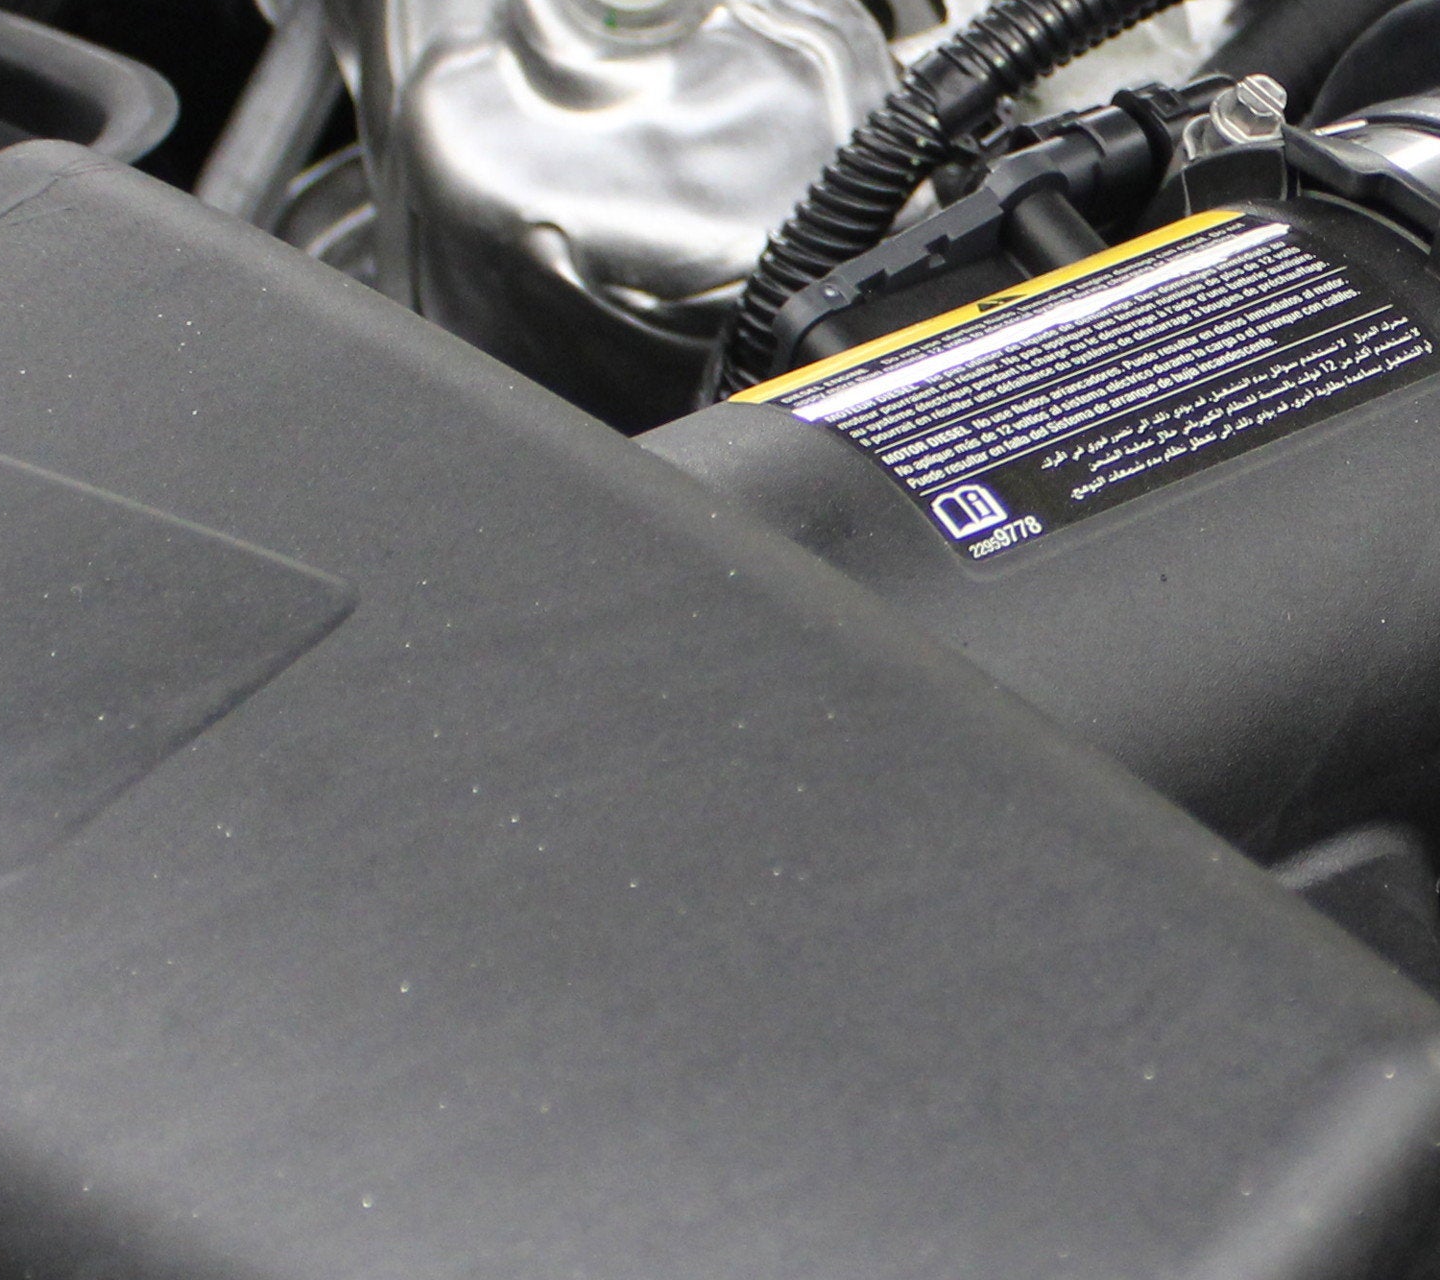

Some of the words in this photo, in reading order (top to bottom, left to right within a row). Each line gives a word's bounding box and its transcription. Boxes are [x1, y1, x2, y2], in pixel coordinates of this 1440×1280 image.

[1257, 255, 1275, 265] 12
[881, 441, 928, 464] MOTOR
[925, 425, 971, 447] DIESEL
[971, 417, 991, 429] No
[989, 409, 1013, 423] use
[1010, 394, 1050, 414] fluidos
[1049, 366, 1124, 399] arrancadores.
[1121, 351, 1159, 369] Puede
[1157, 335, 1198, 356] resultar
[1198, 329, 1215, 340] en
[1213, 316, 1247, 334] daños
[1243, 294, 1303, 321] inmediatos
[1301, 288, 1315, 299] al
[1313, 277, 1348, 294] motor.
[893, 464, 914, 477] No
[912, 448, 955, 470] aplique
[953, 437, 981, 453] más
[979, 431, 998, 443] de
[995, 423, 1014, 436] 12
[1012, 410, 1050, 430] voltios
[1048, 403, 1062, 416] al
[1060, 387, 1107, 411] sistema
[1105, 368, 1154, 392] eléctrico
[1152, 352, 1194, 373] durante
[1190, 347, 1207, 358] la
[1204, 336, 1237, 353] carga
[1234, 332, 1246, 341] o
[1243, 326, 1258, 338] el
[1255, 310, 1303, 333] arranque
[1300, 301, 1324, 315] con
[1321, 288, 1360, 307] cables.
[906, 469, 945, 489] Puede
[943, 451, 988, 474] resultar
[988, 444, 1006, 457] en
[1002, 434, 1031, 450] falla
[1028, 425, 1049, 440] del
[1045, 408, 1095, 432] Sistema
[1092, 402, 1110, 414] de
[1108, 383, 1158, 408] arranque
[1156, 377, 1174, 389] de
[1169, 366, 1200, 383] bujía
[1196, 337, 1276, 372] incandescente.
[1319, 359, 1337, 372] 12
[969, 515, 1041, 557] 22959778
